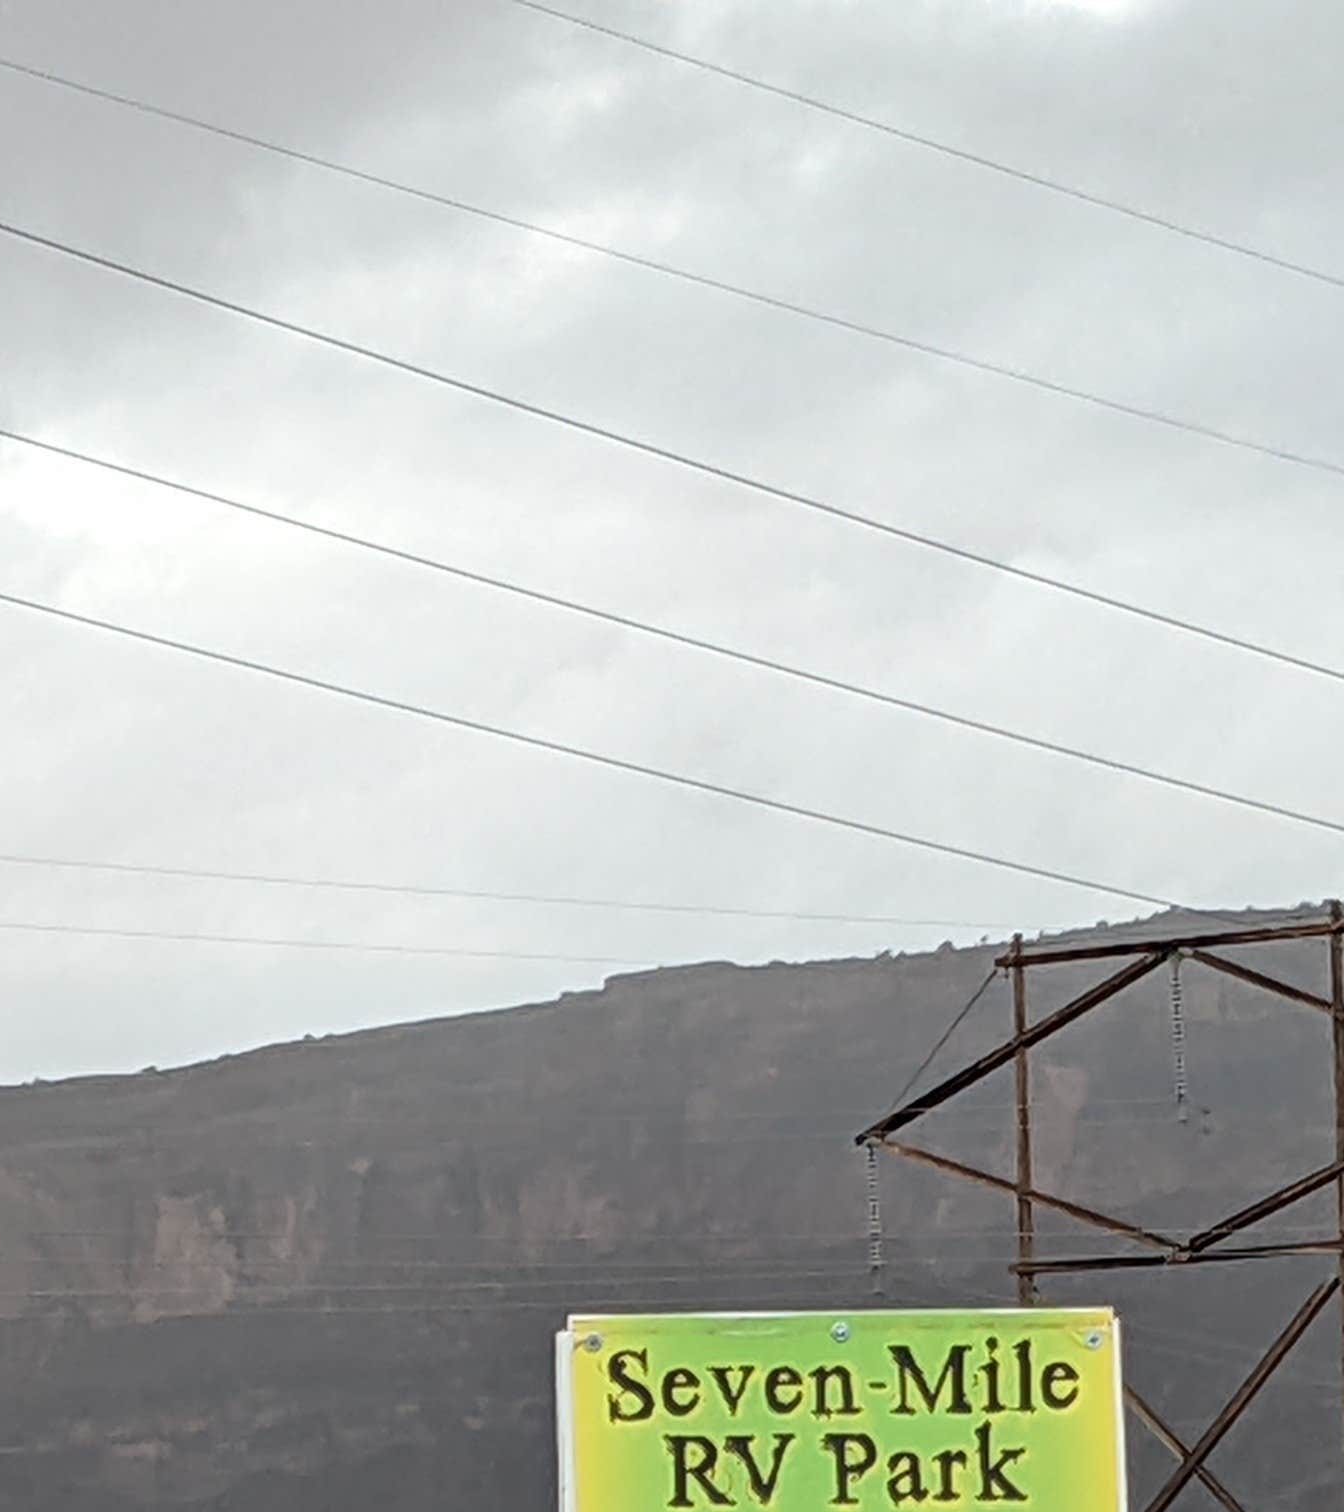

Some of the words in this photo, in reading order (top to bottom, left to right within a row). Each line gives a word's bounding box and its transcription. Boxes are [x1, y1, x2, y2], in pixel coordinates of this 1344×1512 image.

[608, 1337, 1080, 1422] Seven-Mile
[664, 1433, 795, 1507] RV
[822, 1420, 1028, 1506] Park
